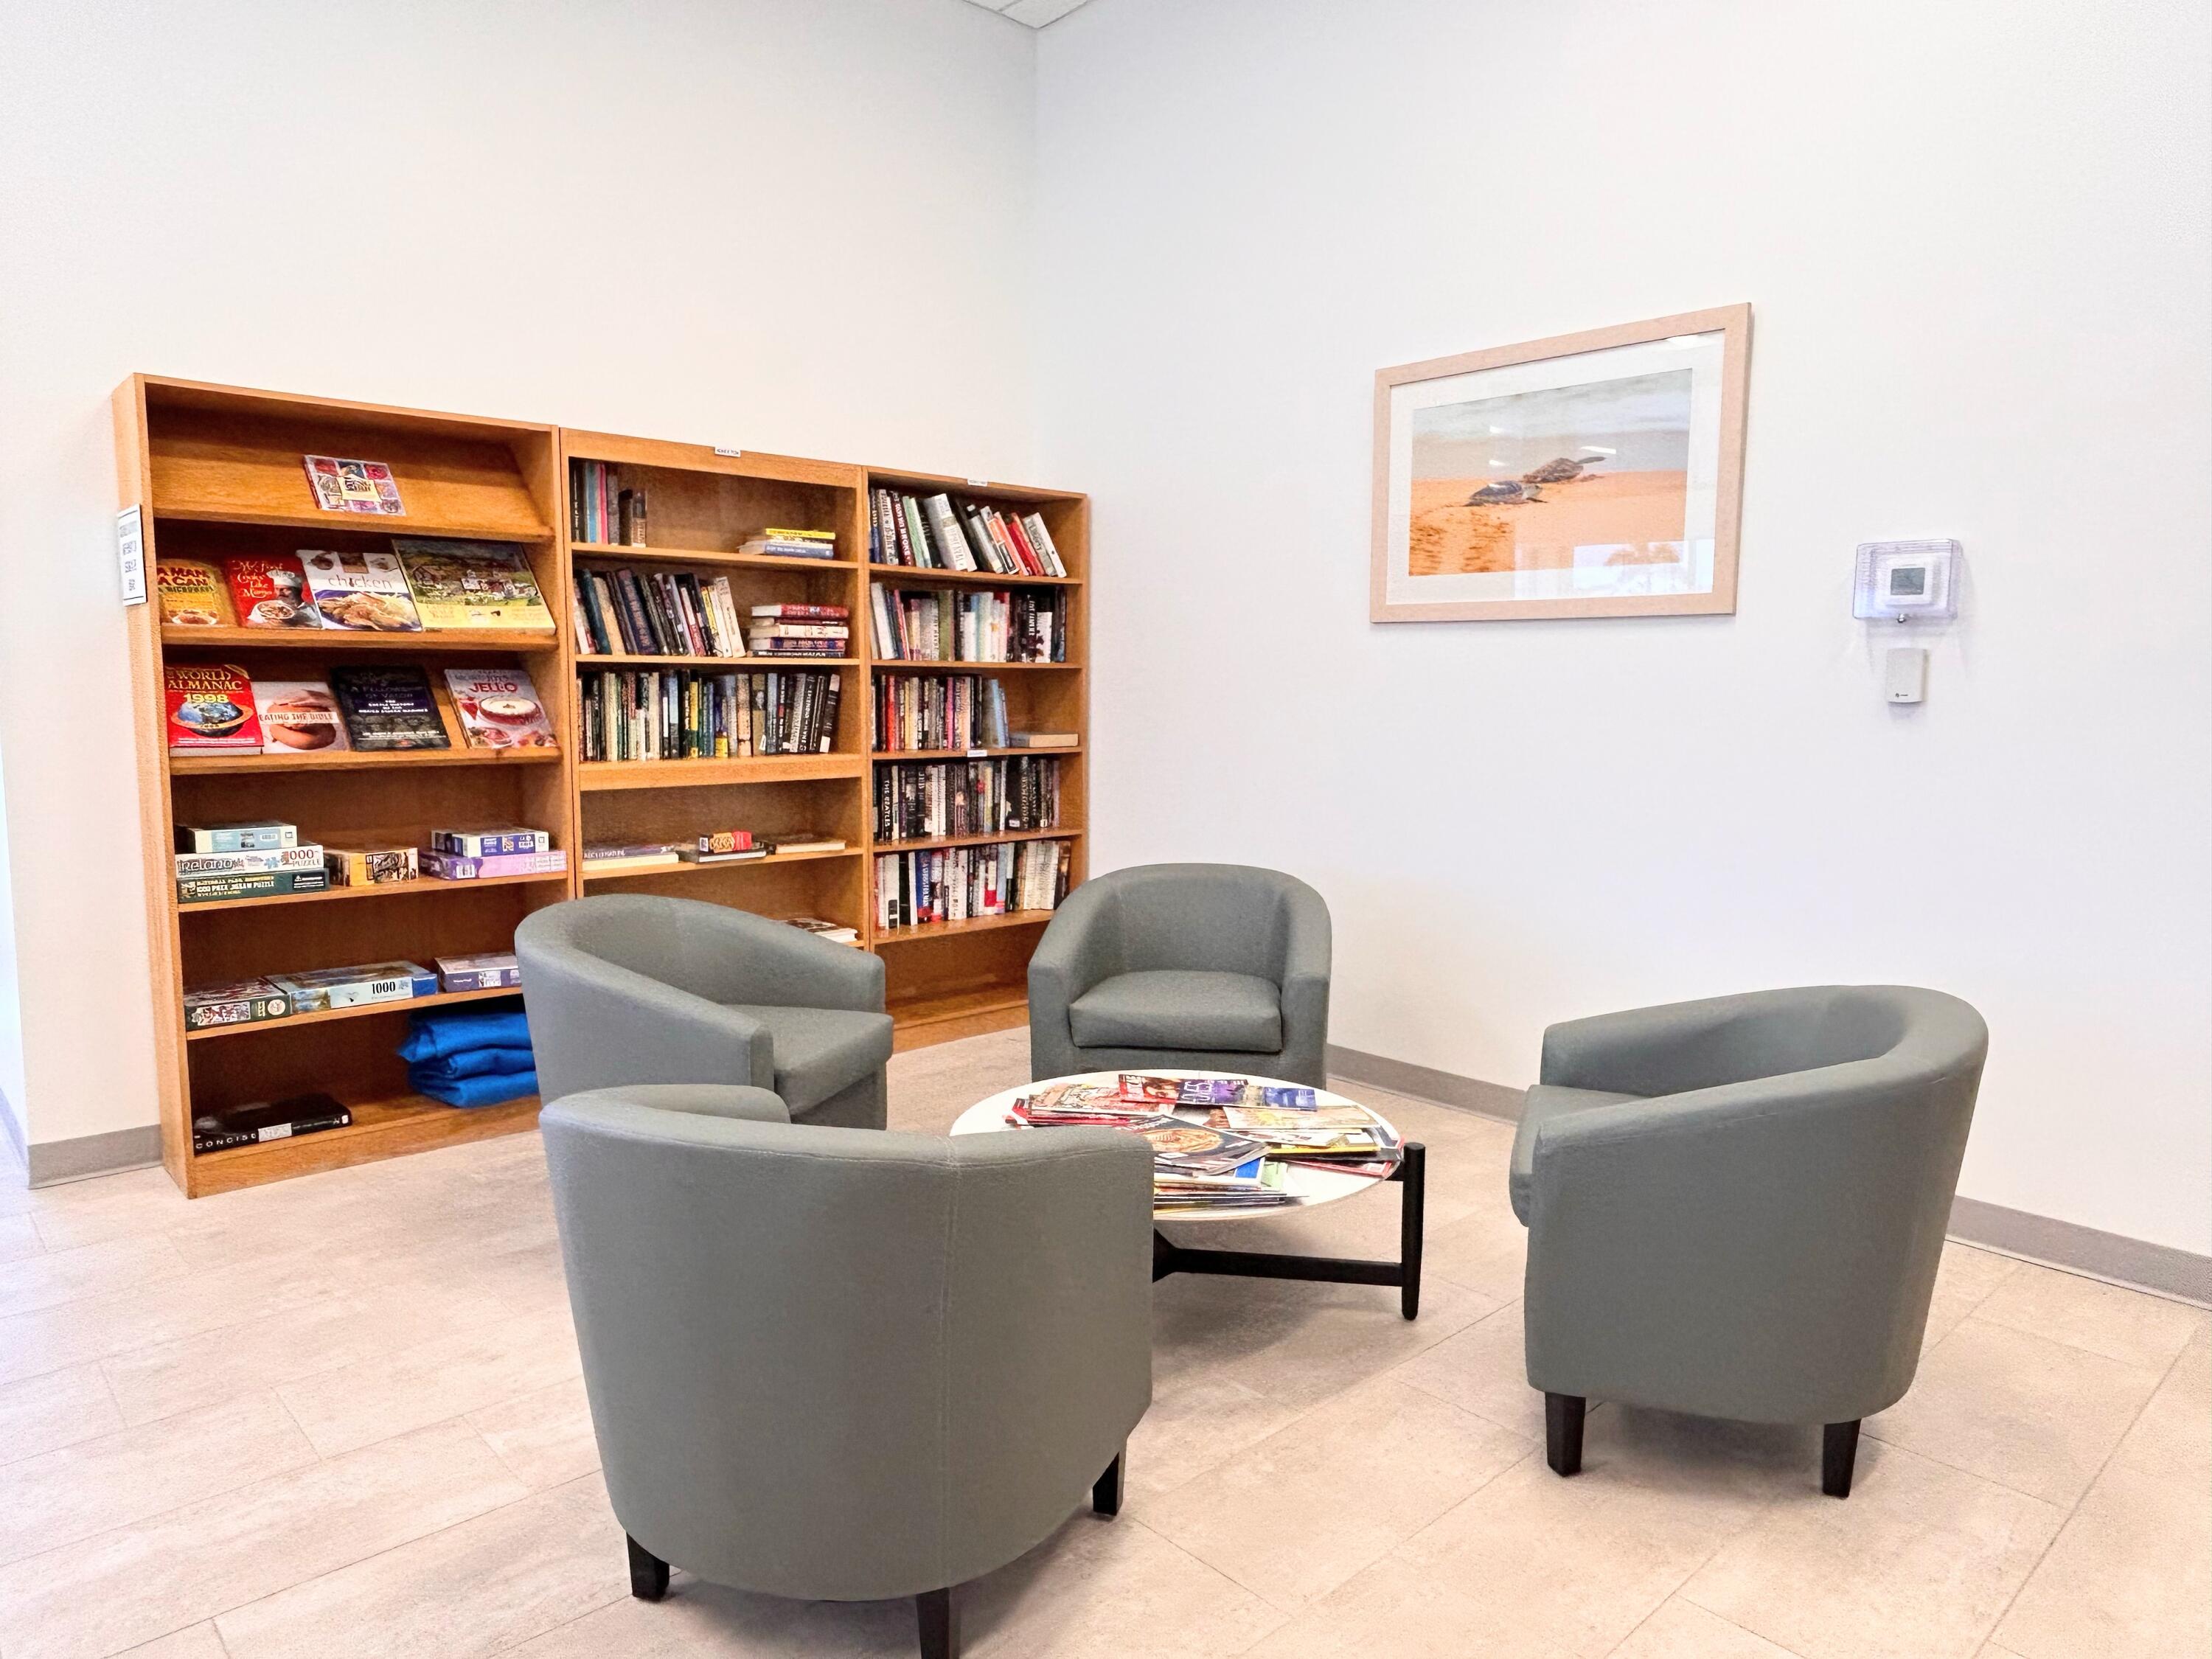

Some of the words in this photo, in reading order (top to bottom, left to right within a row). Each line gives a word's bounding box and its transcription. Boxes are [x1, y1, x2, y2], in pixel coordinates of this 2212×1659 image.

[329, 573, 393, 589] chicken
[177, 670, 231, 680] WORLD
[169, 680, 243, 690] ALMANAC
[184, 693, 230, 703] 1998
[258, 713, 290, 722] EATING
[309, 712, 333, 720] BIBLE
[372, 981, 393, 995] 1000
